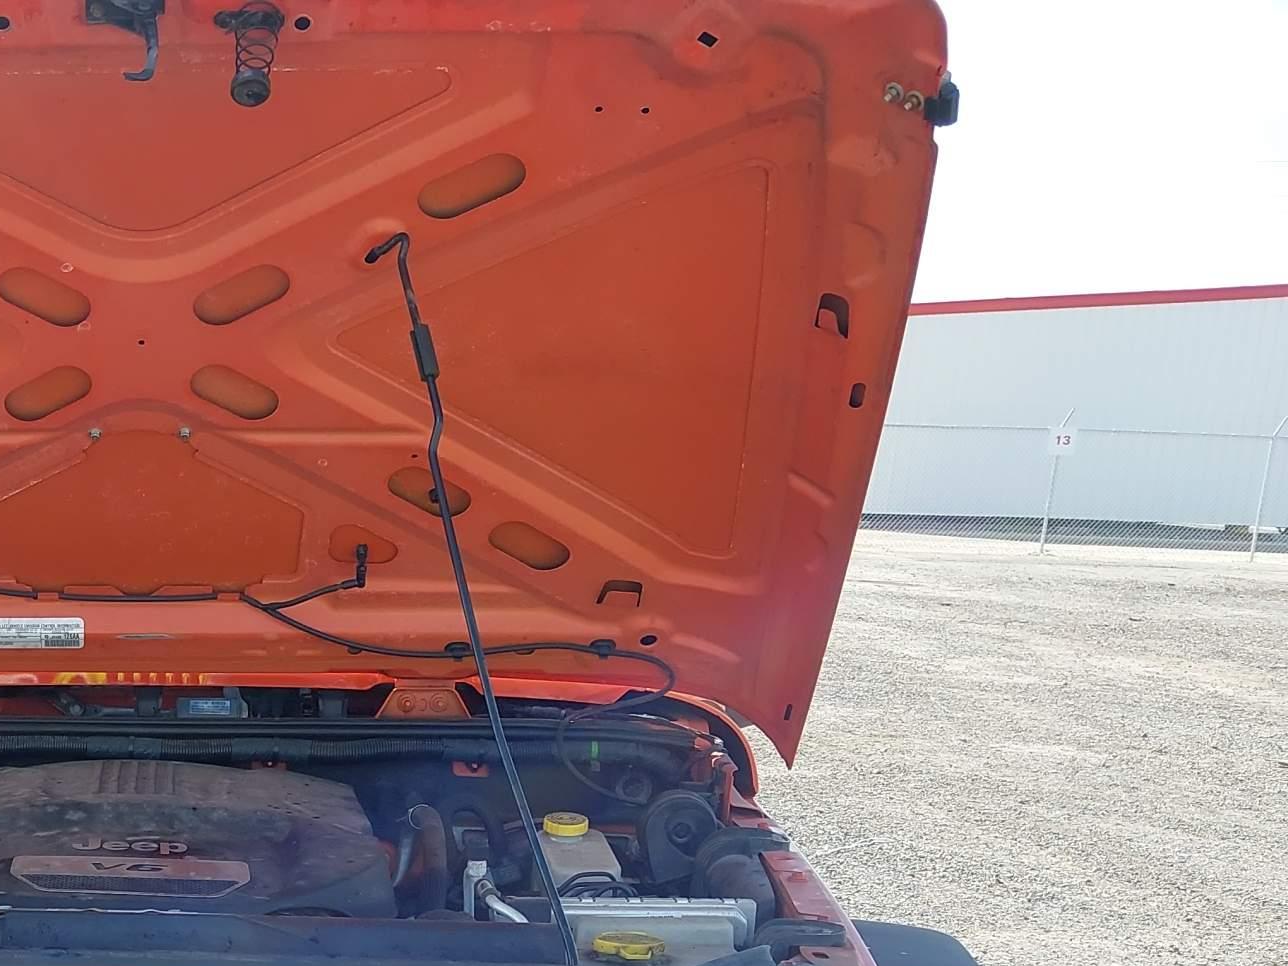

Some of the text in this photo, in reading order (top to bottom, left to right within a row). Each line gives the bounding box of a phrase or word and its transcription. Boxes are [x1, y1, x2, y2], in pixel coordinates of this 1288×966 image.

[1056, 435, 1072, 446] 13
[71, 836, 188, 855] Jeep
[91, 862, 169, 873] V6
